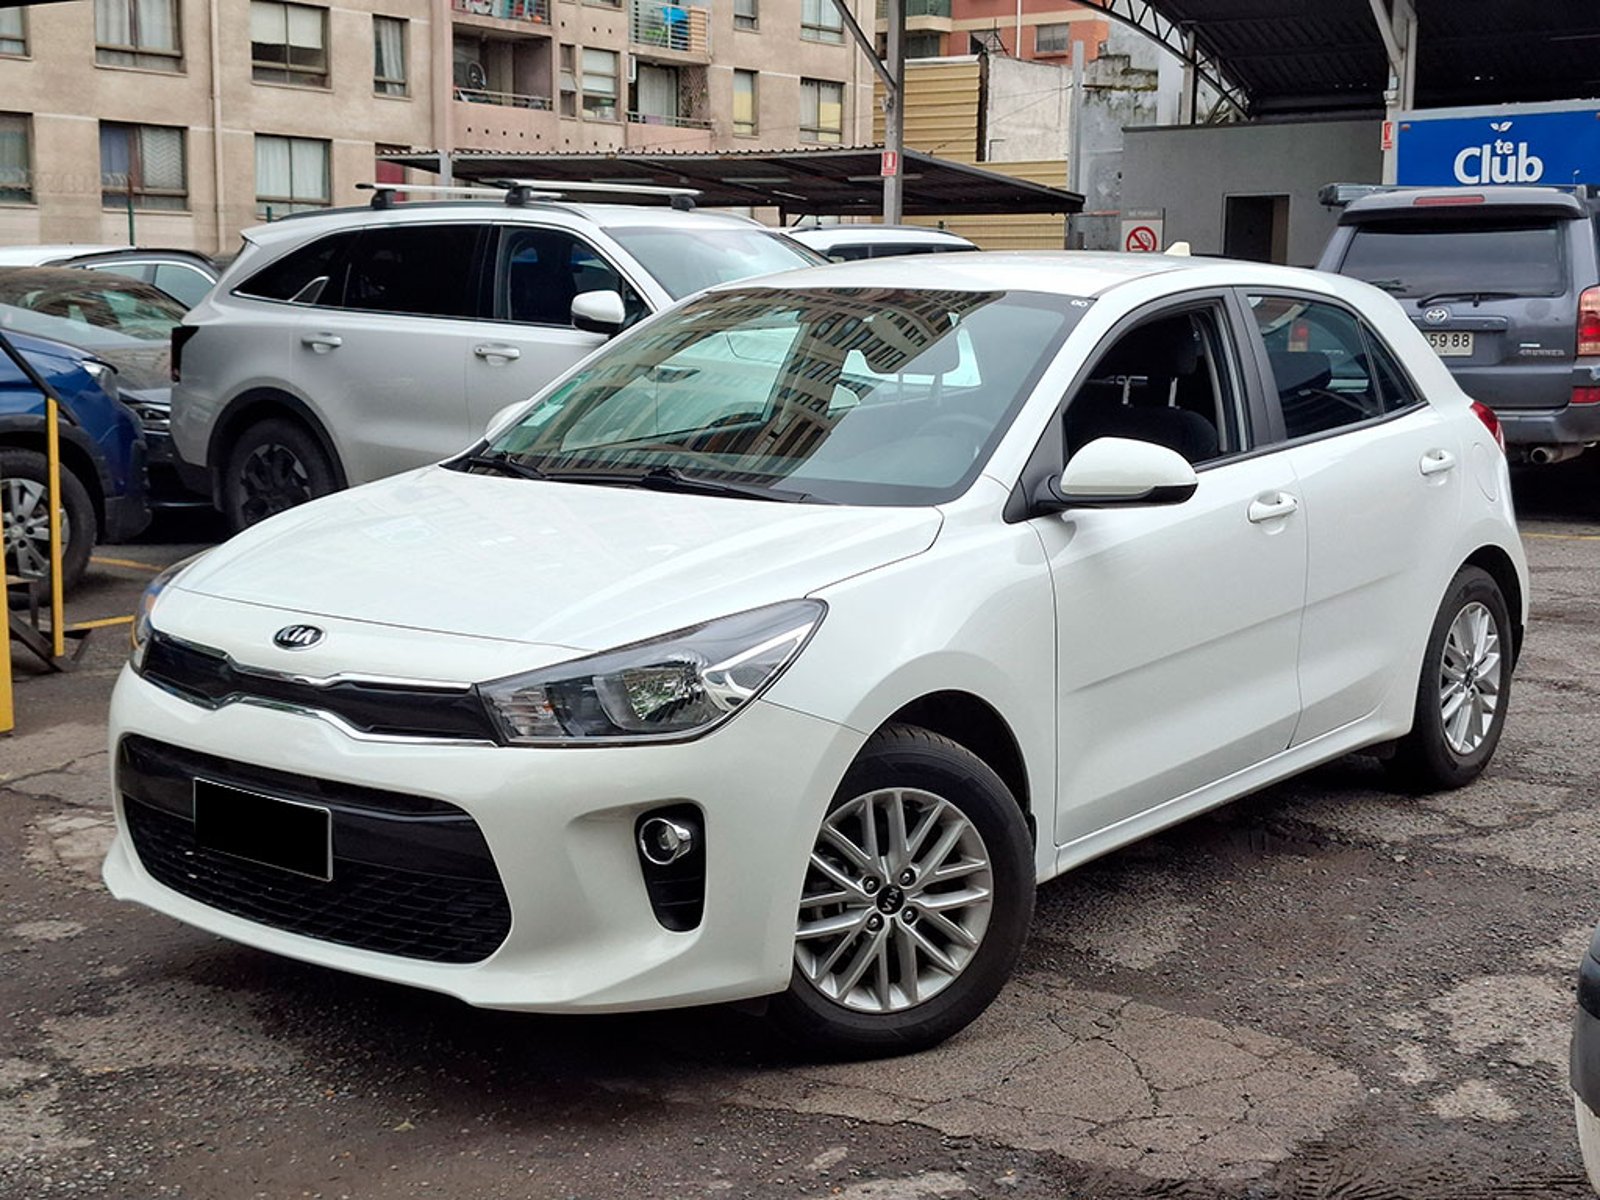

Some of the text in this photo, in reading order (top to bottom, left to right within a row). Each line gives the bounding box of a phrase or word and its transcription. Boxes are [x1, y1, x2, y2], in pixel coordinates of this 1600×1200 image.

[1494, 139, 1514, 154] te
[1453, 142, 1544, 184] Club
[276, 626, 316, 645] KIA
